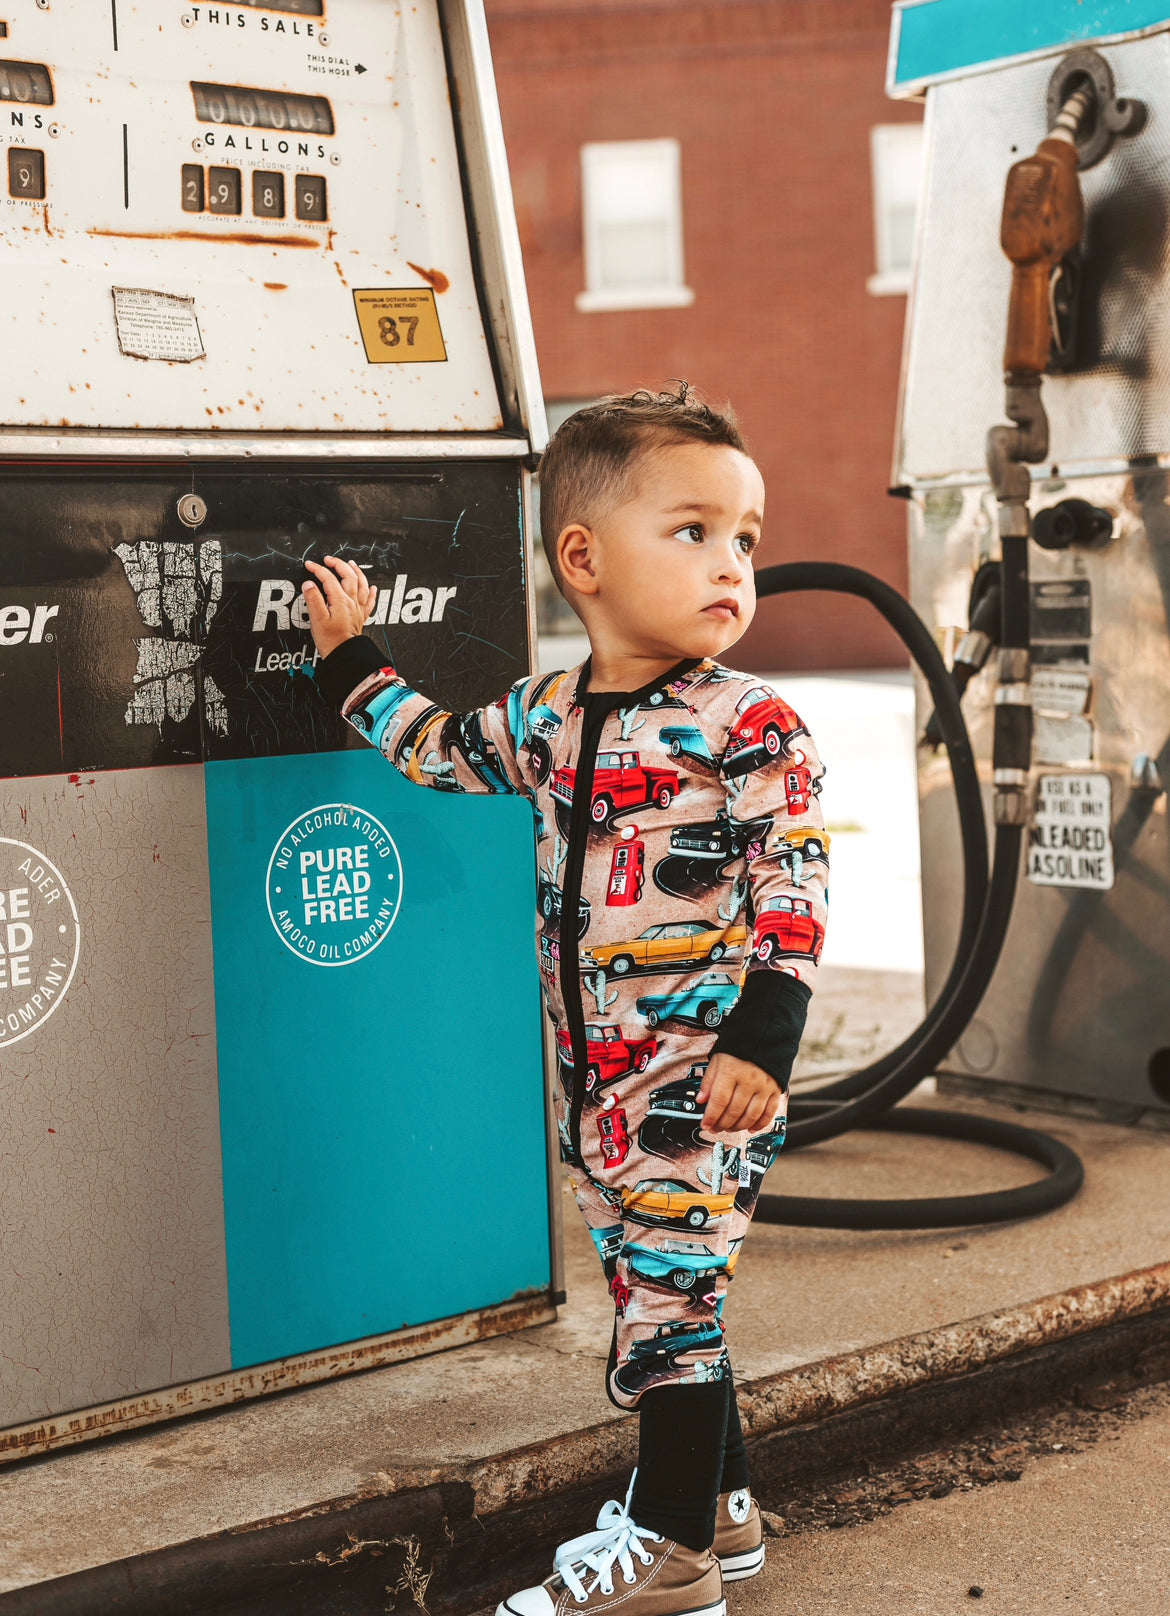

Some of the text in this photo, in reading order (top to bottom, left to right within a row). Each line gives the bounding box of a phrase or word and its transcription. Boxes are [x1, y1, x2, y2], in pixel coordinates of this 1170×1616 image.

[192, 8, 314, 36] THIS SALE
[307, 54, 349, 65] THIS DIAL
[308, 65, 350, 76] THIS HOSE
[9, 136, 26, 144] TAX
[205, 132, 325, 158] GALLONS
[19, 168, 30, 188] 9
[220, 157, 310, 173] PRICE INCLUDING TAX
[21, 200, 53, 208] PRESSURE
[378, 316, 419, 347] 87
[252, 574, 457, 632] Reular
[276, 811, 391, 869] NO ALCOHOL ADDED
[1028, 825, 1105, 852] NLEADED
[300, 845, 370, 874] PURE
[302, 871, 371, 900] LEAD
[304, 896, 370, 925] FREE
[277, 898, 394, 958] AMOCO OIL COMPANY
